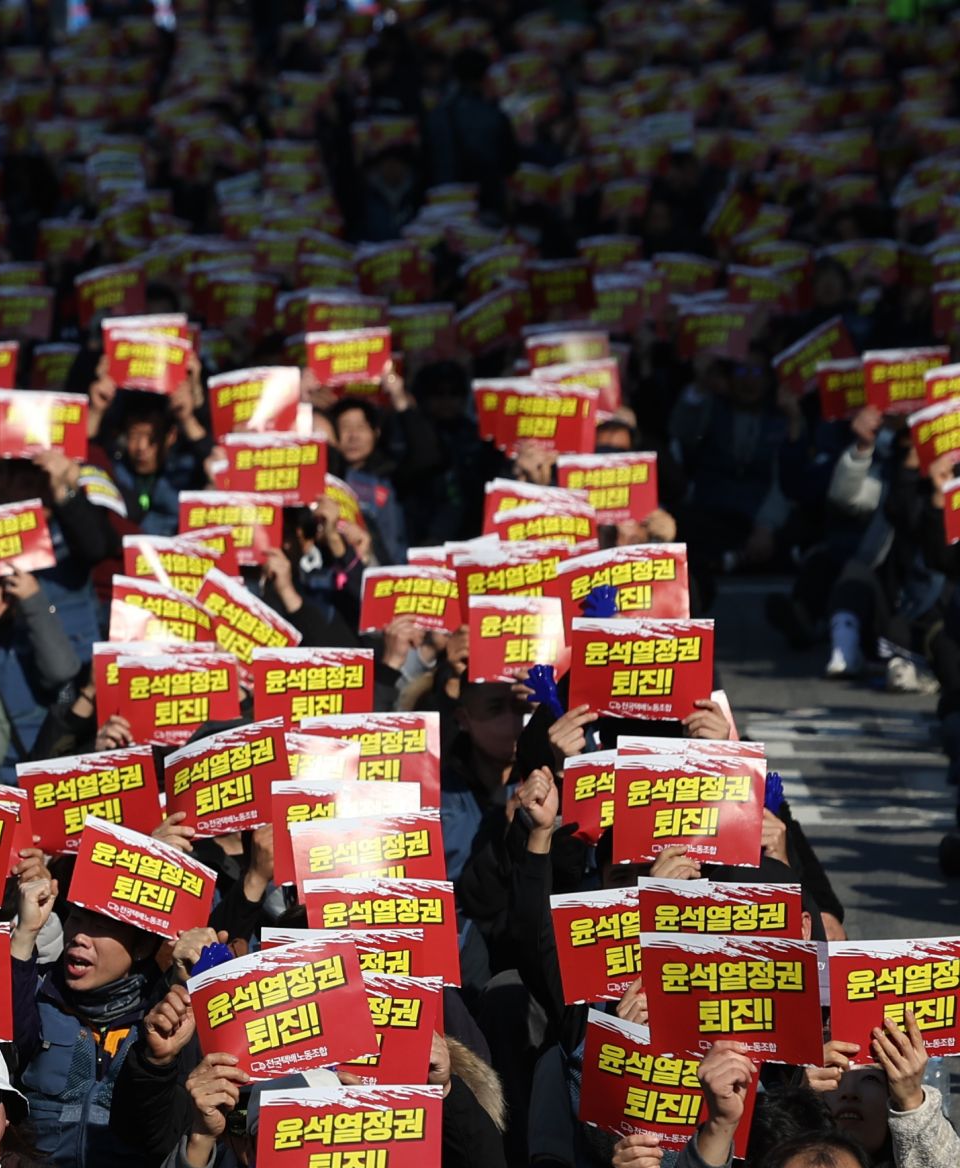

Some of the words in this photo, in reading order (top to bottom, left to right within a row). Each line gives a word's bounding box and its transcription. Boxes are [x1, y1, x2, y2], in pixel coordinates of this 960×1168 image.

[373, 578, 459, 598] 윤석열정권
[466, 557, 561, 596] 윤석열정권
[570, 559, 676, 600] 윤석열정권
[203, 594, 288, 648] 윤석열정권
[394, 595, 446, 615] 퇴진!
[216, 624, 258, 664] 퇴진!
[584, 637, 701, 666] 윤석열정권
[129, 669, 229, 700] 윤석열정권
[265, 665, 364, 694] 윤석열정권
[611, 668, 673, 696] 퇴진!
[154, 697, 209, 726] 퇴진!
[173, 737, 275, 795] 윤석열정권
[33, 764, 144, 809] 윤석열정권
[194, 774, 253, 816] 퇴진!
[626, 775, 752, 807] 윤석열정권
[652, 807, 719, 838] 퇴진!
[307, 830, 431, 871] 윤석열정권
[90, 842, 204, 896] 윤석열정권
[110, 875, 177, 912] 퇴진!
[322, 897, 443, 929] 윤석열정권
[570, 911, 641, 946] 윤석열
[654, 902, 786, 932] 윤석열정권
[206, 955, 346, 1028] 윤석열정권
[661, 960, 803, 992] 윤석열정권
[244, 1002, 321, 1054] 퇴진!
[698, 997, 773, 1033] 퇴진!
[266, 1047, 328, 1068] 전국택배노동조합
[597, 1043, 702, 1088] 윤석열정
[623, 1087, 702, 1125] 퇴진!
[273, 1108, 425, 1150] 윤석열정권
